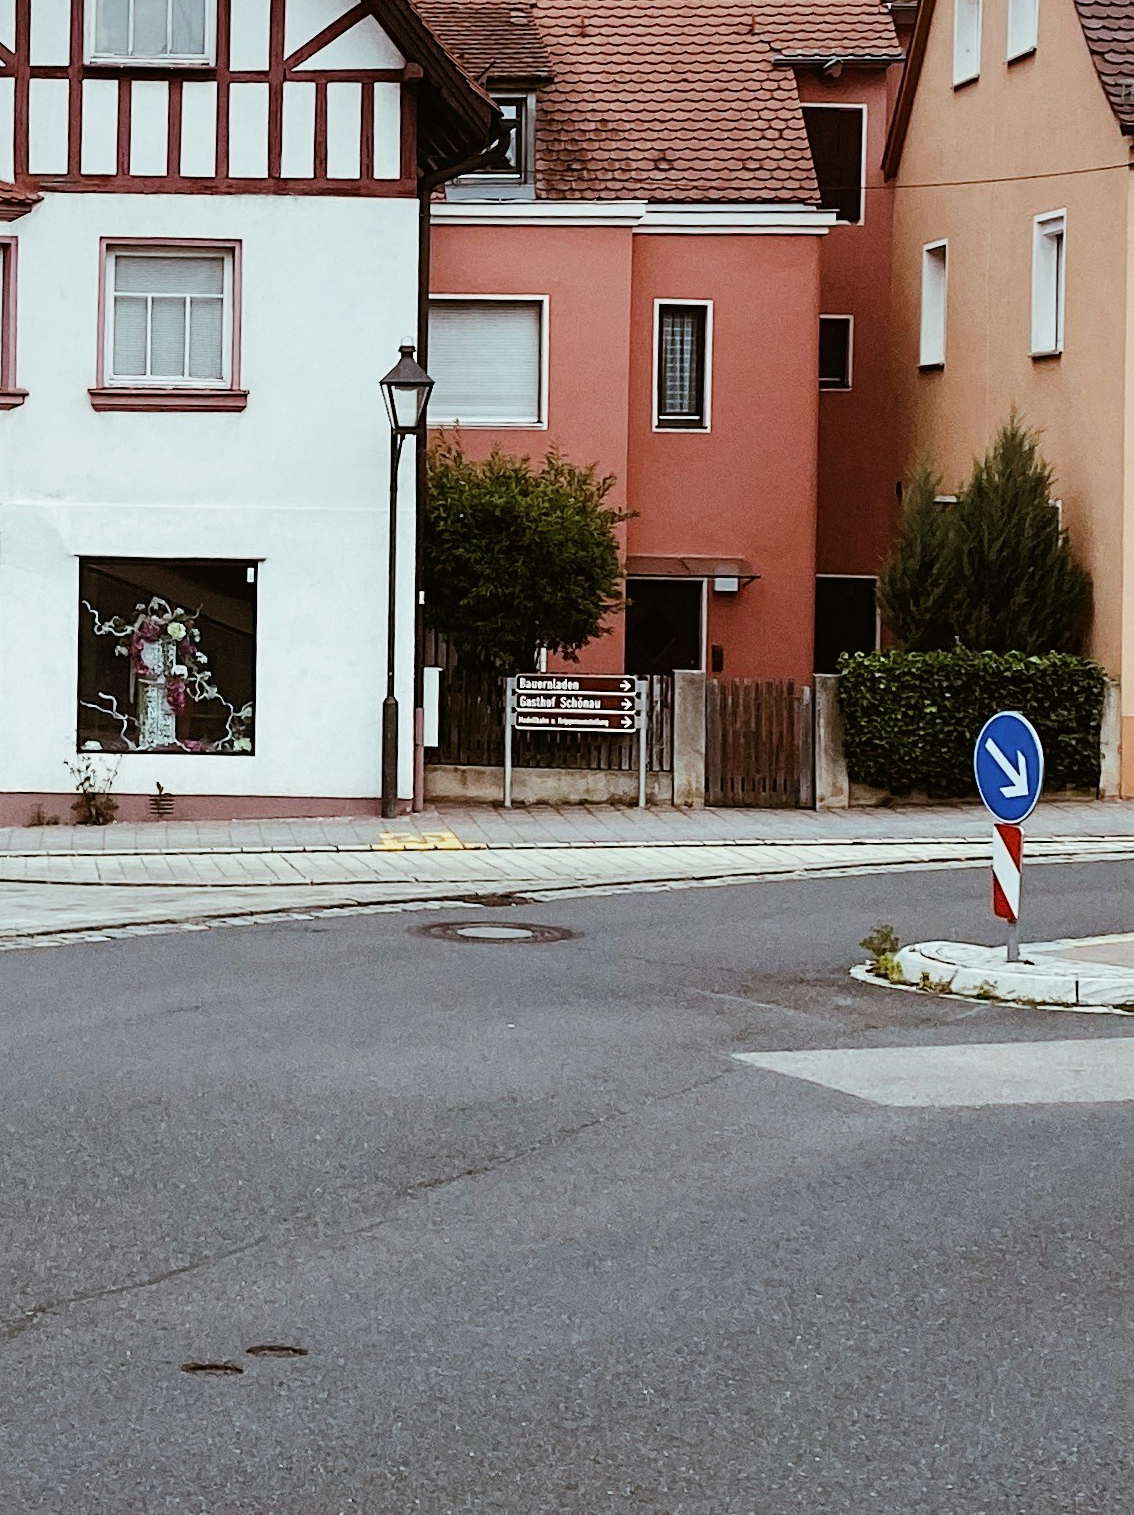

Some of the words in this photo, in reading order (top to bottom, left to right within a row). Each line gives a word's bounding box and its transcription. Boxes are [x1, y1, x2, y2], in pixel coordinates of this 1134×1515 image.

[519, 677, 579, 690] Bauernladen
[519, 696, 556, 708] Gasthof
[560, 696, 601, 709] Schönau
